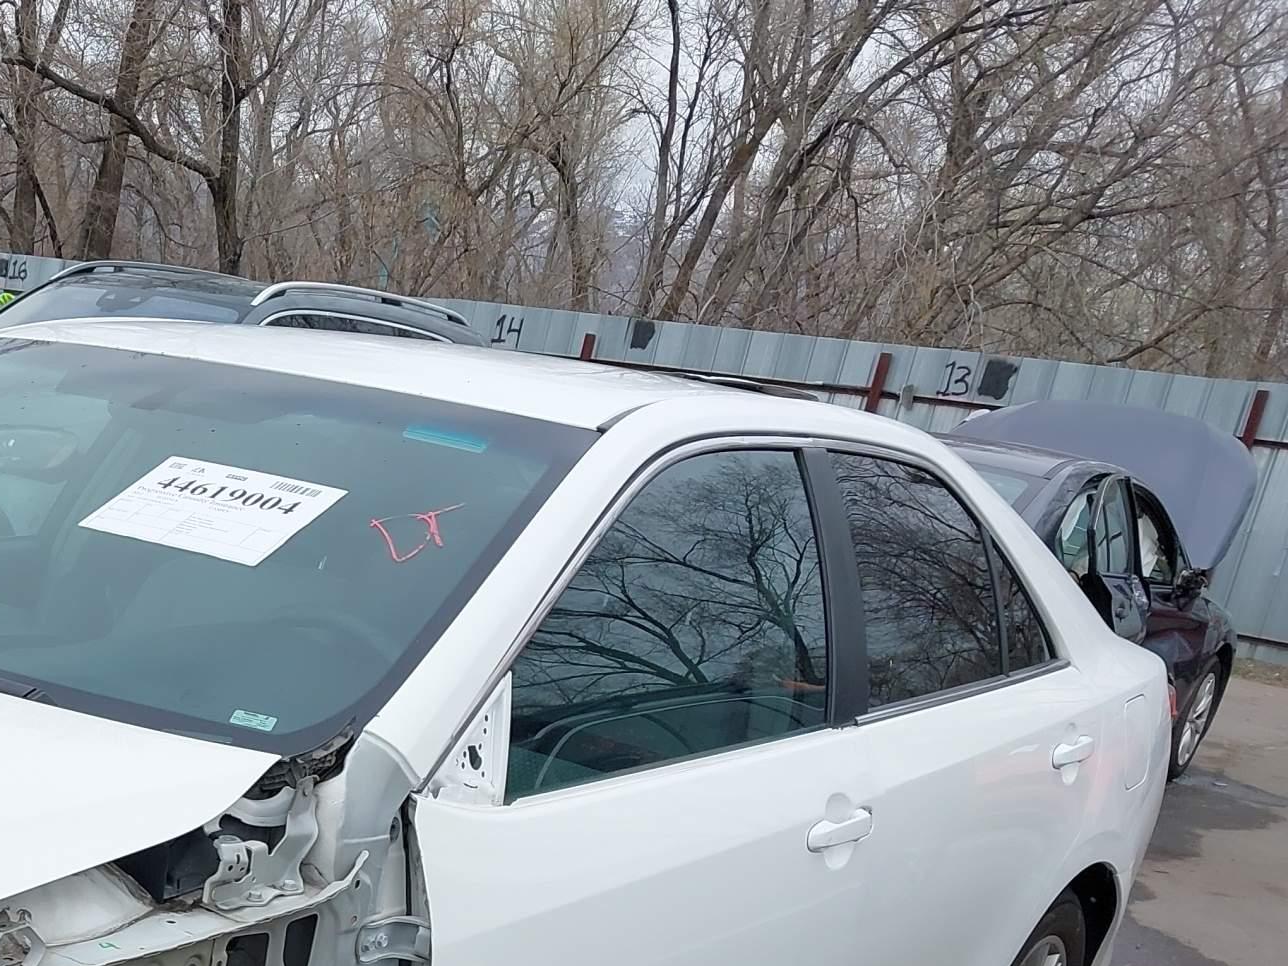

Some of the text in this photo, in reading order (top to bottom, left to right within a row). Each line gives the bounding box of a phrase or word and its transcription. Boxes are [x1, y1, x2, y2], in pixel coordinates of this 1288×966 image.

[9, 259, 27, 280] 16
[491, 314, 524, 349] 14
[936, 361, 971, 396] 13
[156, 475, 303, 515] 44619004
